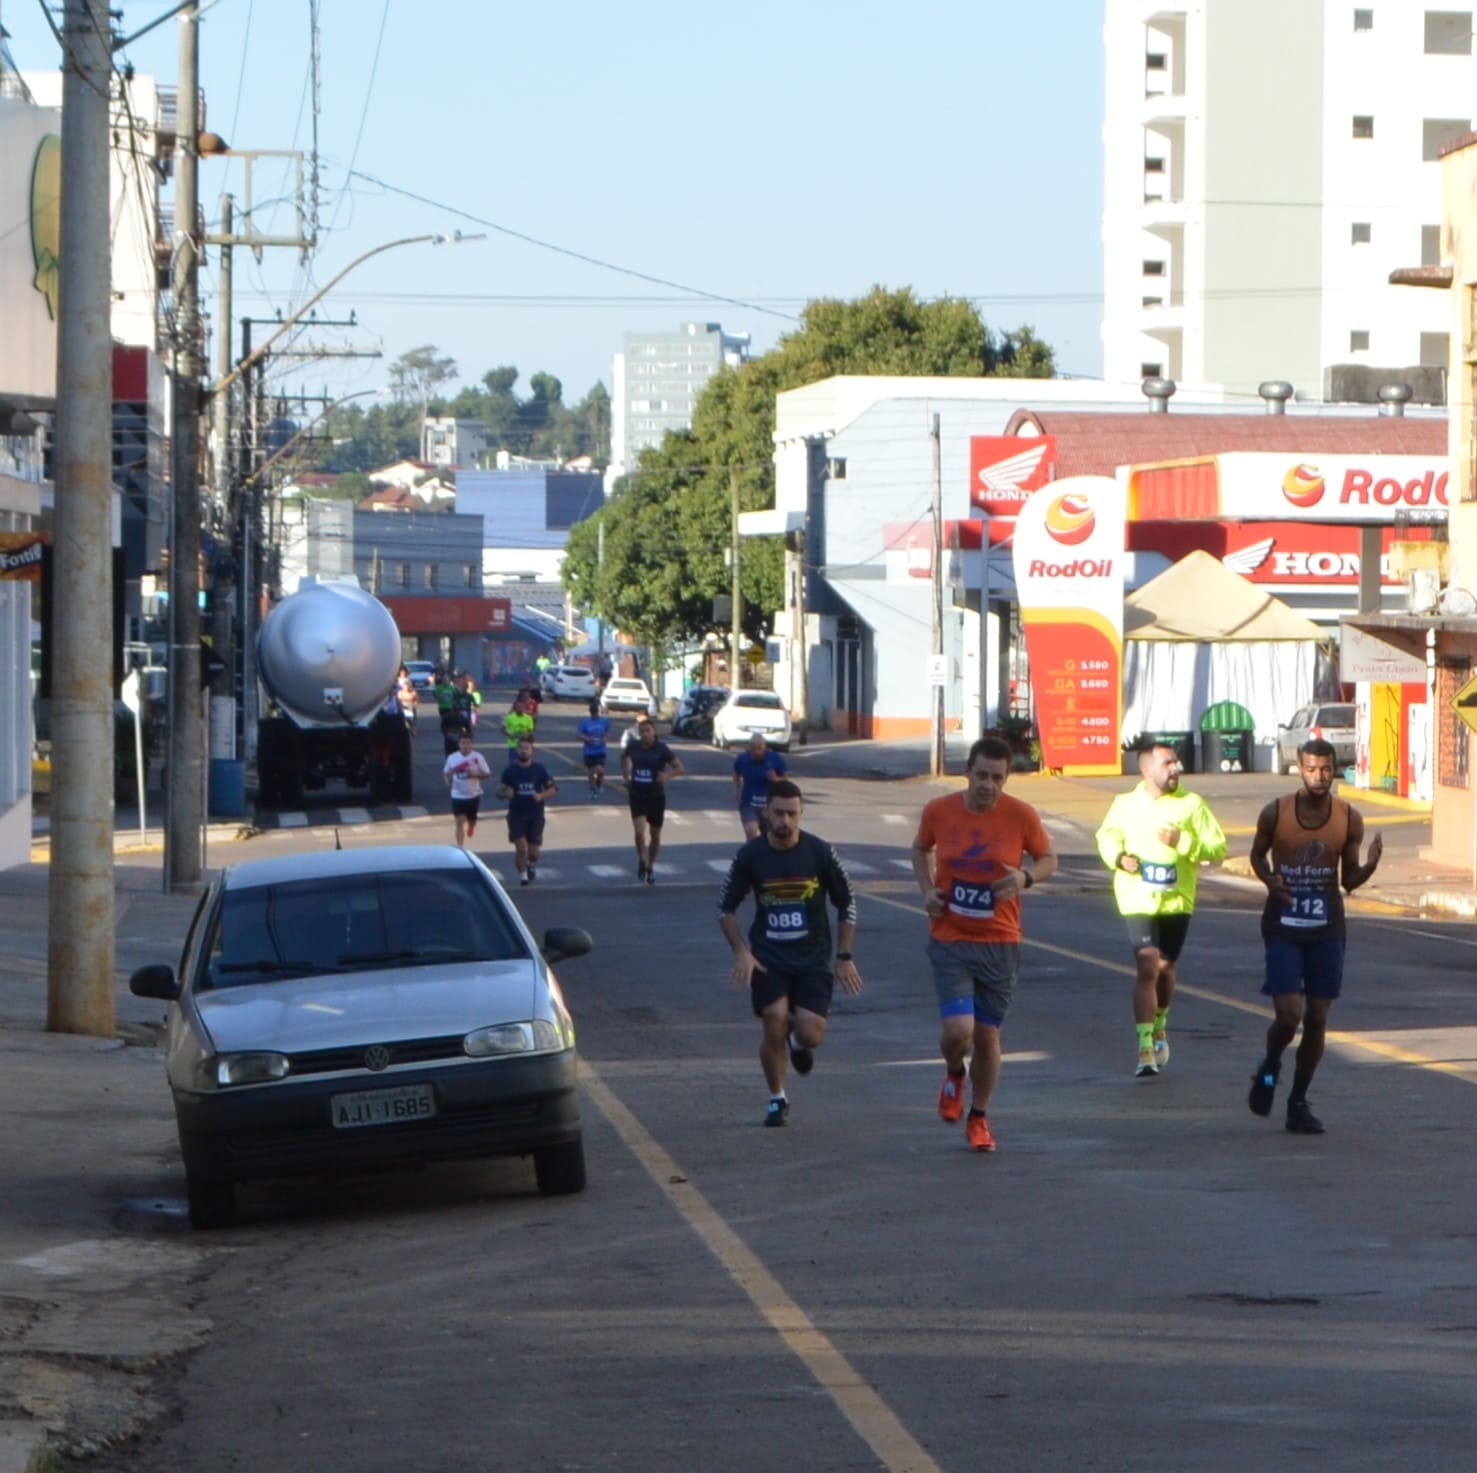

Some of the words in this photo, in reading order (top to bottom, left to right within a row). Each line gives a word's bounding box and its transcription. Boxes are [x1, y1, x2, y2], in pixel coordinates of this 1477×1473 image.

[978, 490, 1033, 500] HOND
[1339, 468, 1448, 506] Rod
[1029, 560, 1112, 577] RodOil
[954, 885, 992, 905] 074
[1291, 897, 1324, 915] 112
[768, 911, 803, 927] 088
